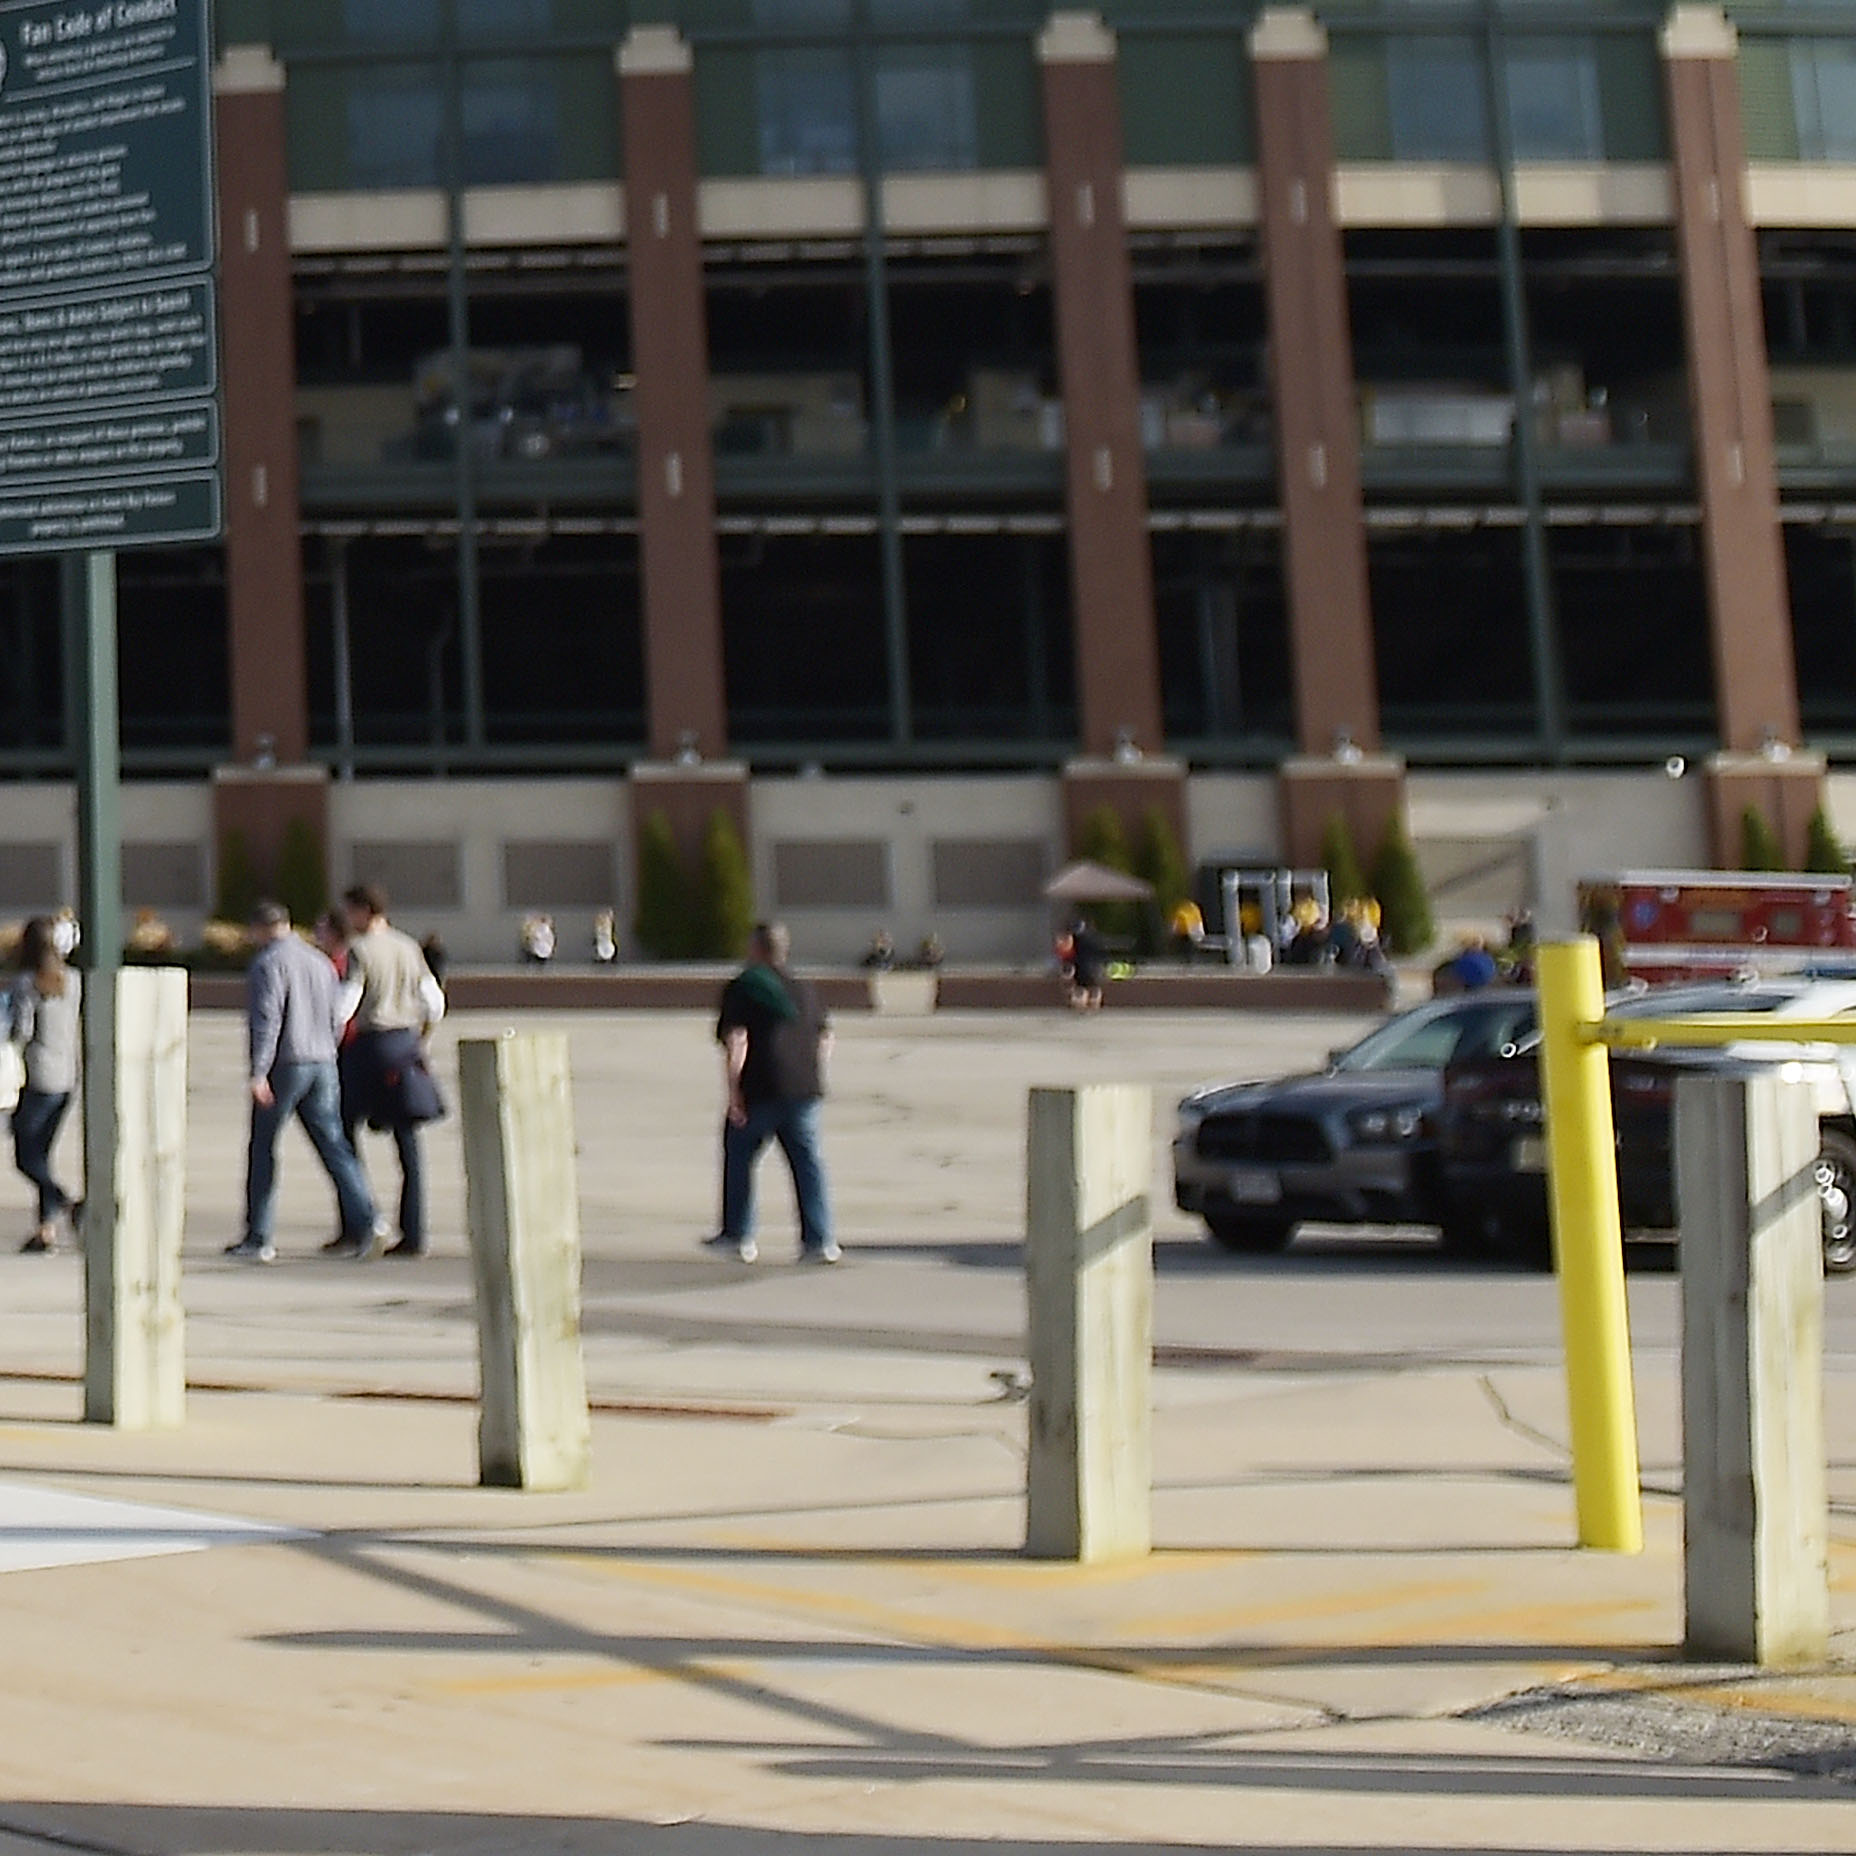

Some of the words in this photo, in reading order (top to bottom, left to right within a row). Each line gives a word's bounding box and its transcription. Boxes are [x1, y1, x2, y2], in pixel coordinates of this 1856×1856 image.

[21, 21, 53, 47] Fan
[54, 10, 94, 42] Code
[94, 3, 114, 33] of
